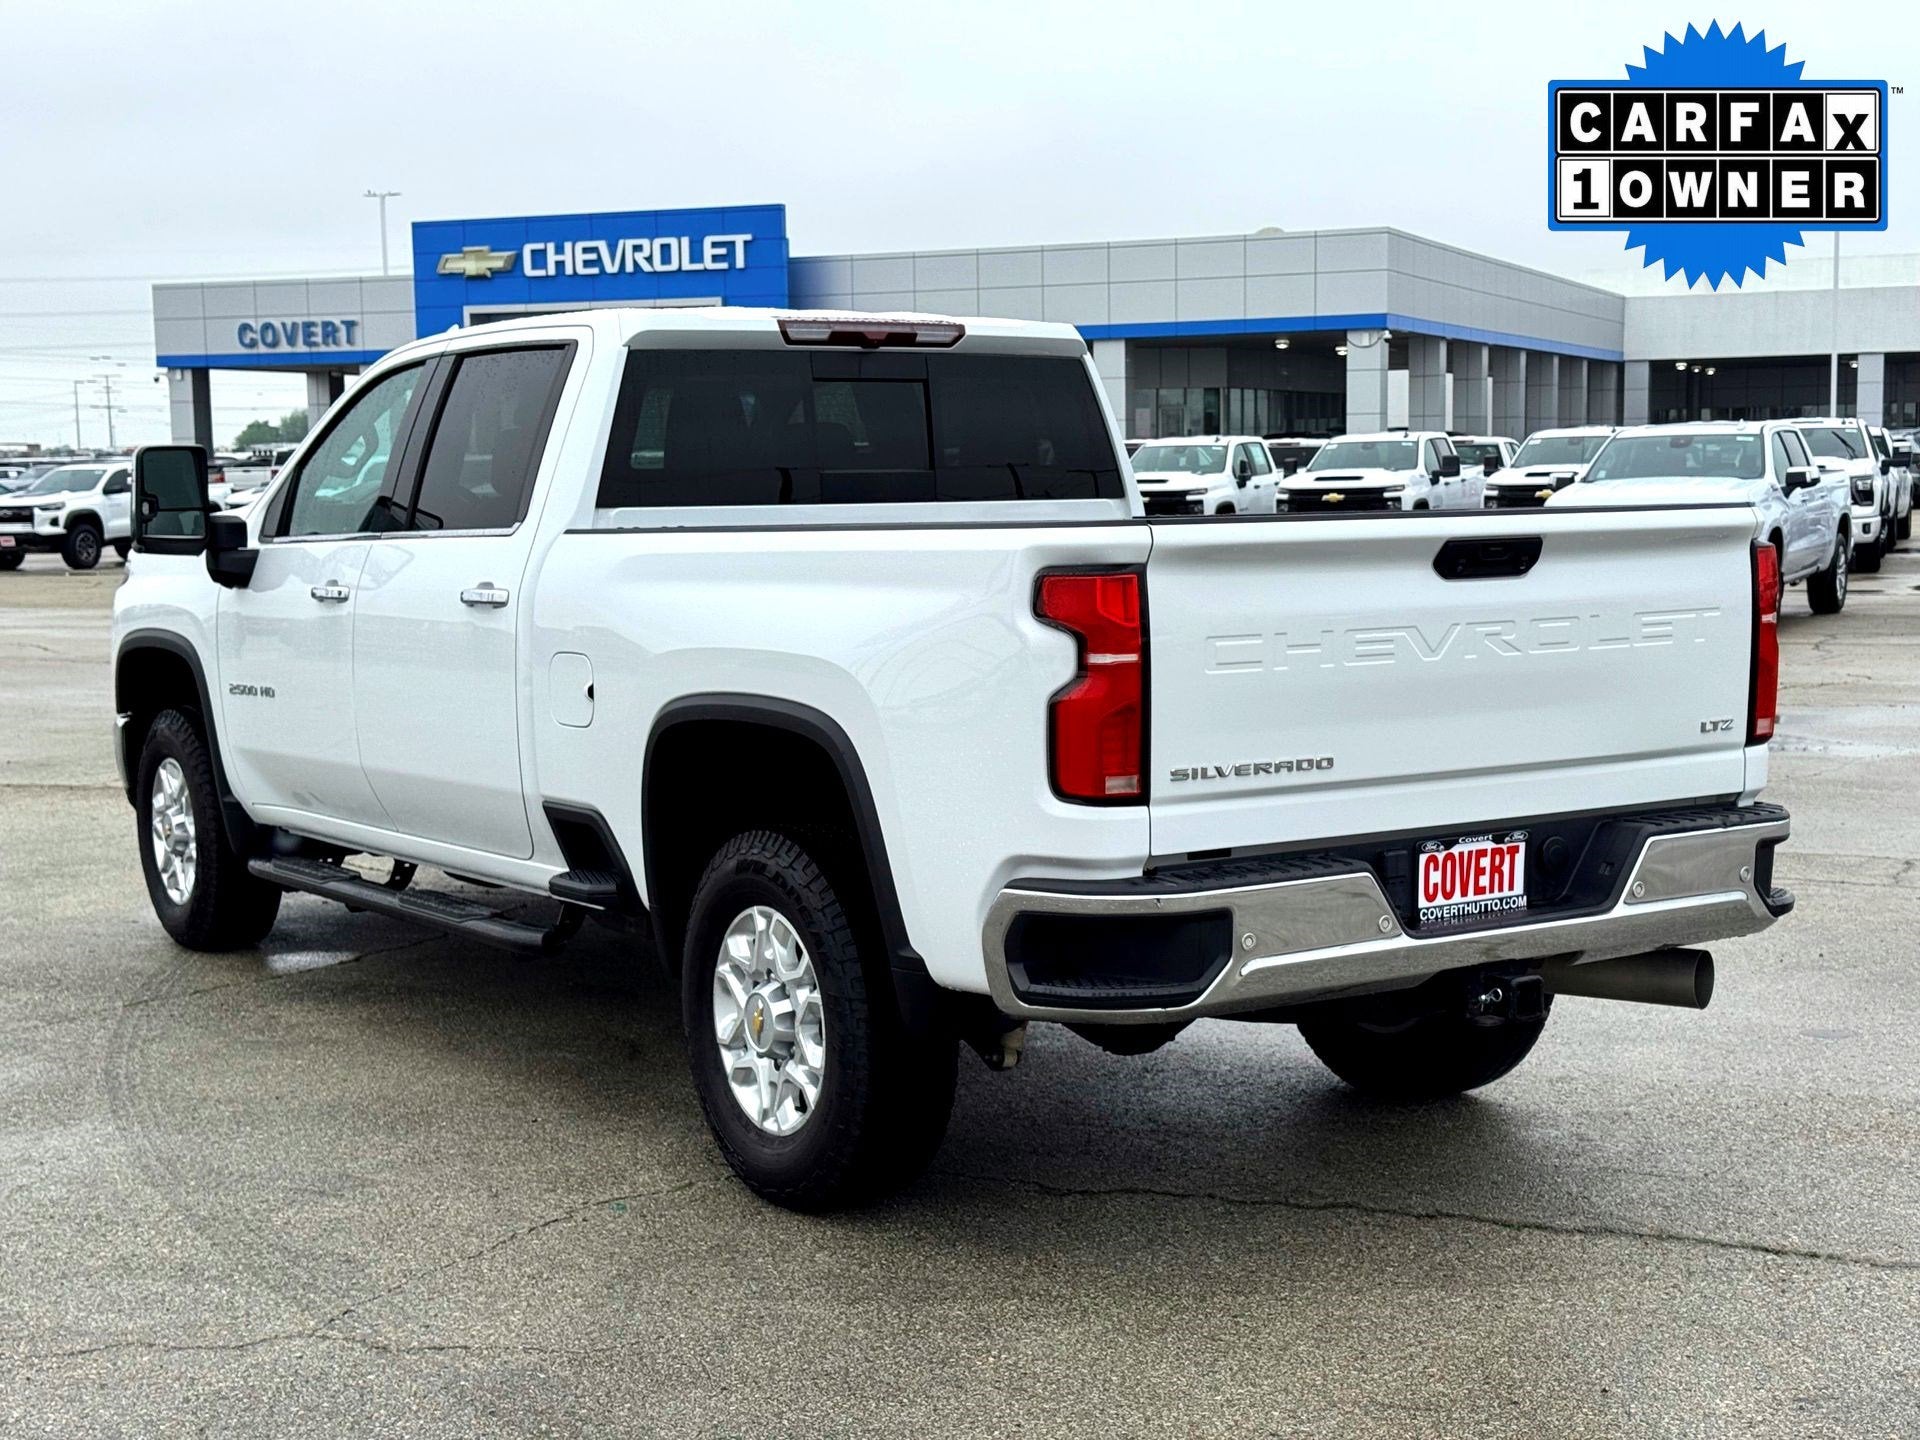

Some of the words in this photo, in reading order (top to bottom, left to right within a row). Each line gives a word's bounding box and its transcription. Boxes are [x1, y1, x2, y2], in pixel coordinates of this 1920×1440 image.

[522, 233, 753, 278] CHEVROLET
[237, 319, 358, 350] COVERT
[1204, 607, 1721, 674] CHEVROLET
[228, 683, 258, 697] 2500
[1700, 718, 1734, 734] LTZ
[1169, 756, 1335, 783] SILVERADO
[1458, 834, 1494, 844] Covert
[1423, 844, 1520, 903] COVERT
[1420, 895, 1528, 921] COVERTHUTTO.COM
